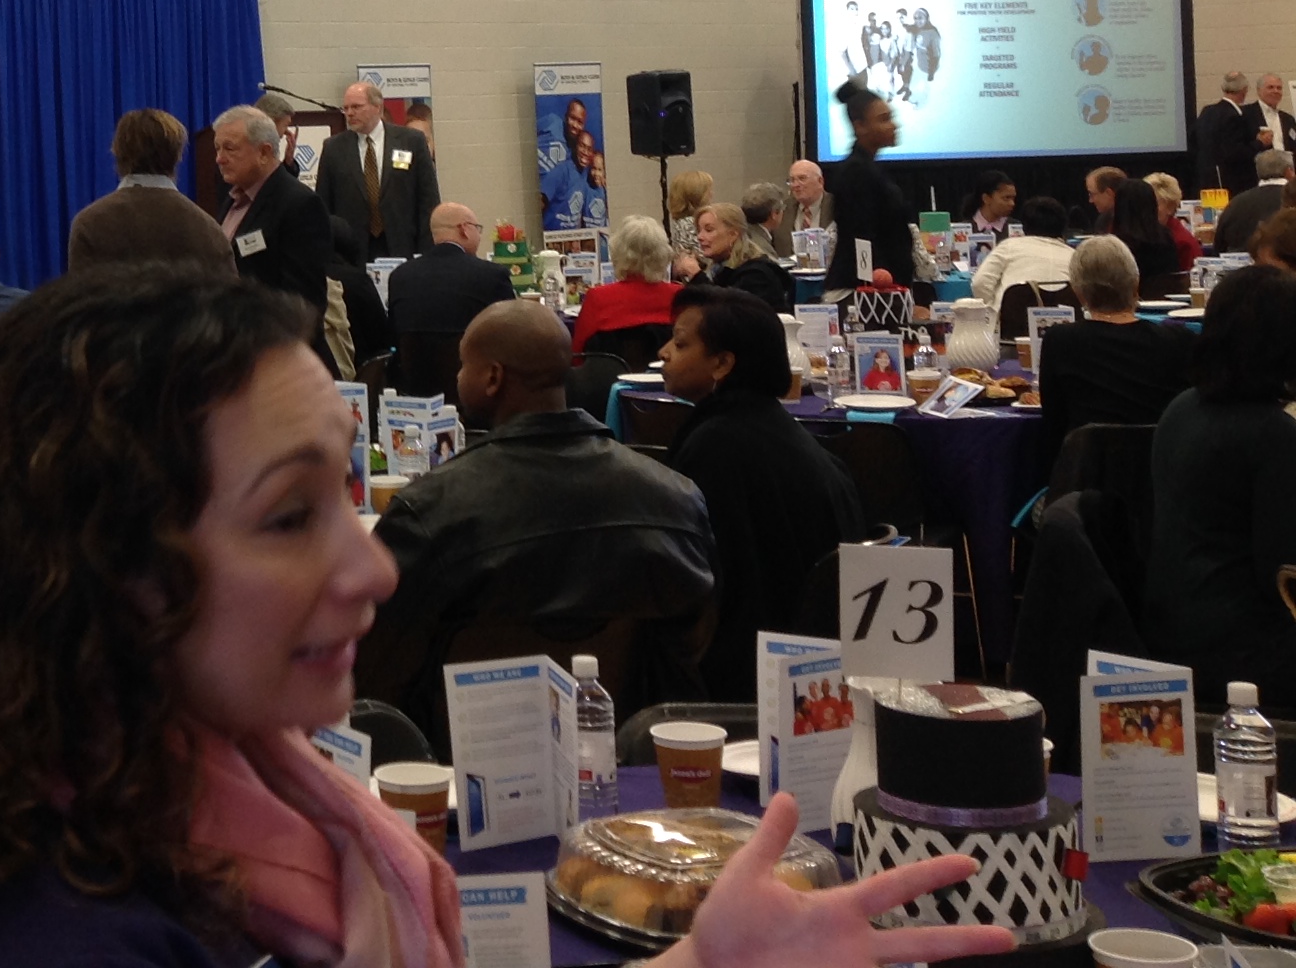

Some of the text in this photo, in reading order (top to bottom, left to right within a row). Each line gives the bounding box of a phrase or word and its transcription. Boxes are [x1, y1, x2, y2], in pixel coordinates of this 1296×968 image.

[860, 251, 868, 270] 8
[851, 577, 944, 645] 13
[489, 890, 518, 902] HELP
